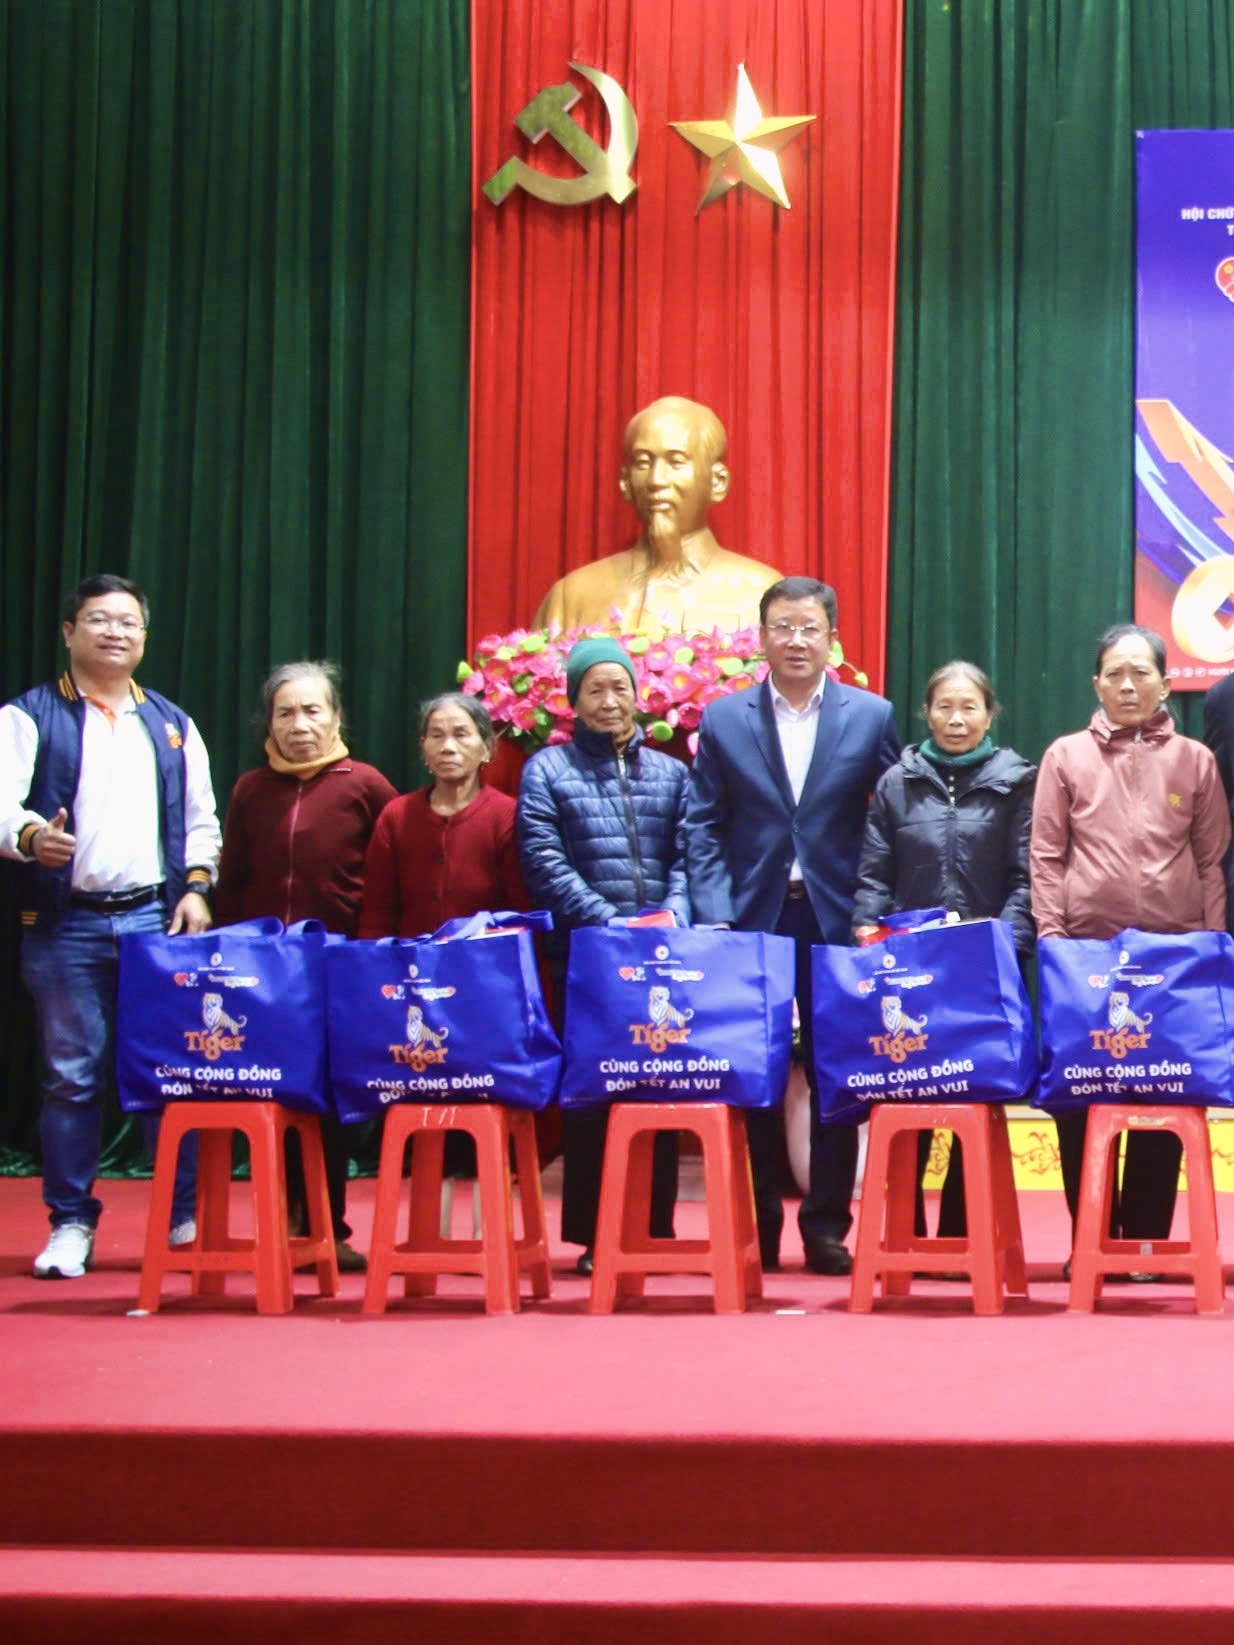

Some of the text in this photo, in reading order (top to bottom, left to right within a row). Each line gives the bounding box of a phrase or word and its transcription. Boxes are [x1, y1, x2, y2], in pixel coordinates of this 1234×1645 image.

[184, 1029, 245, 1060] Tiger
[629, 1022, 692, 1053] Tiger
[1089, 1027, 1152, 1059] Tiger
[868, 1032, 929, 1064] Tiger
[389, 1043, 449, 1073] Tiger
[600, 1058, 639, 1073] CÙNG
[642, 1058, 684, 1075] CỘNG
[847, 1072, 885, 1087] CÙNG
[888, 1068, 928, 1085] CỘNG
[1064, 1064, 1102, 1079] CÙNG
[1105, 1064, 1145, 1081] CỘNG
[669, 1078, 690, 1089] AN
[694, 1078, 721, 1090] VUI
[918, 1085, 938, 1097] AN
[941, 1080, 969, 1093] VUI
[1157, 1082, 1184, 1093] VUI
